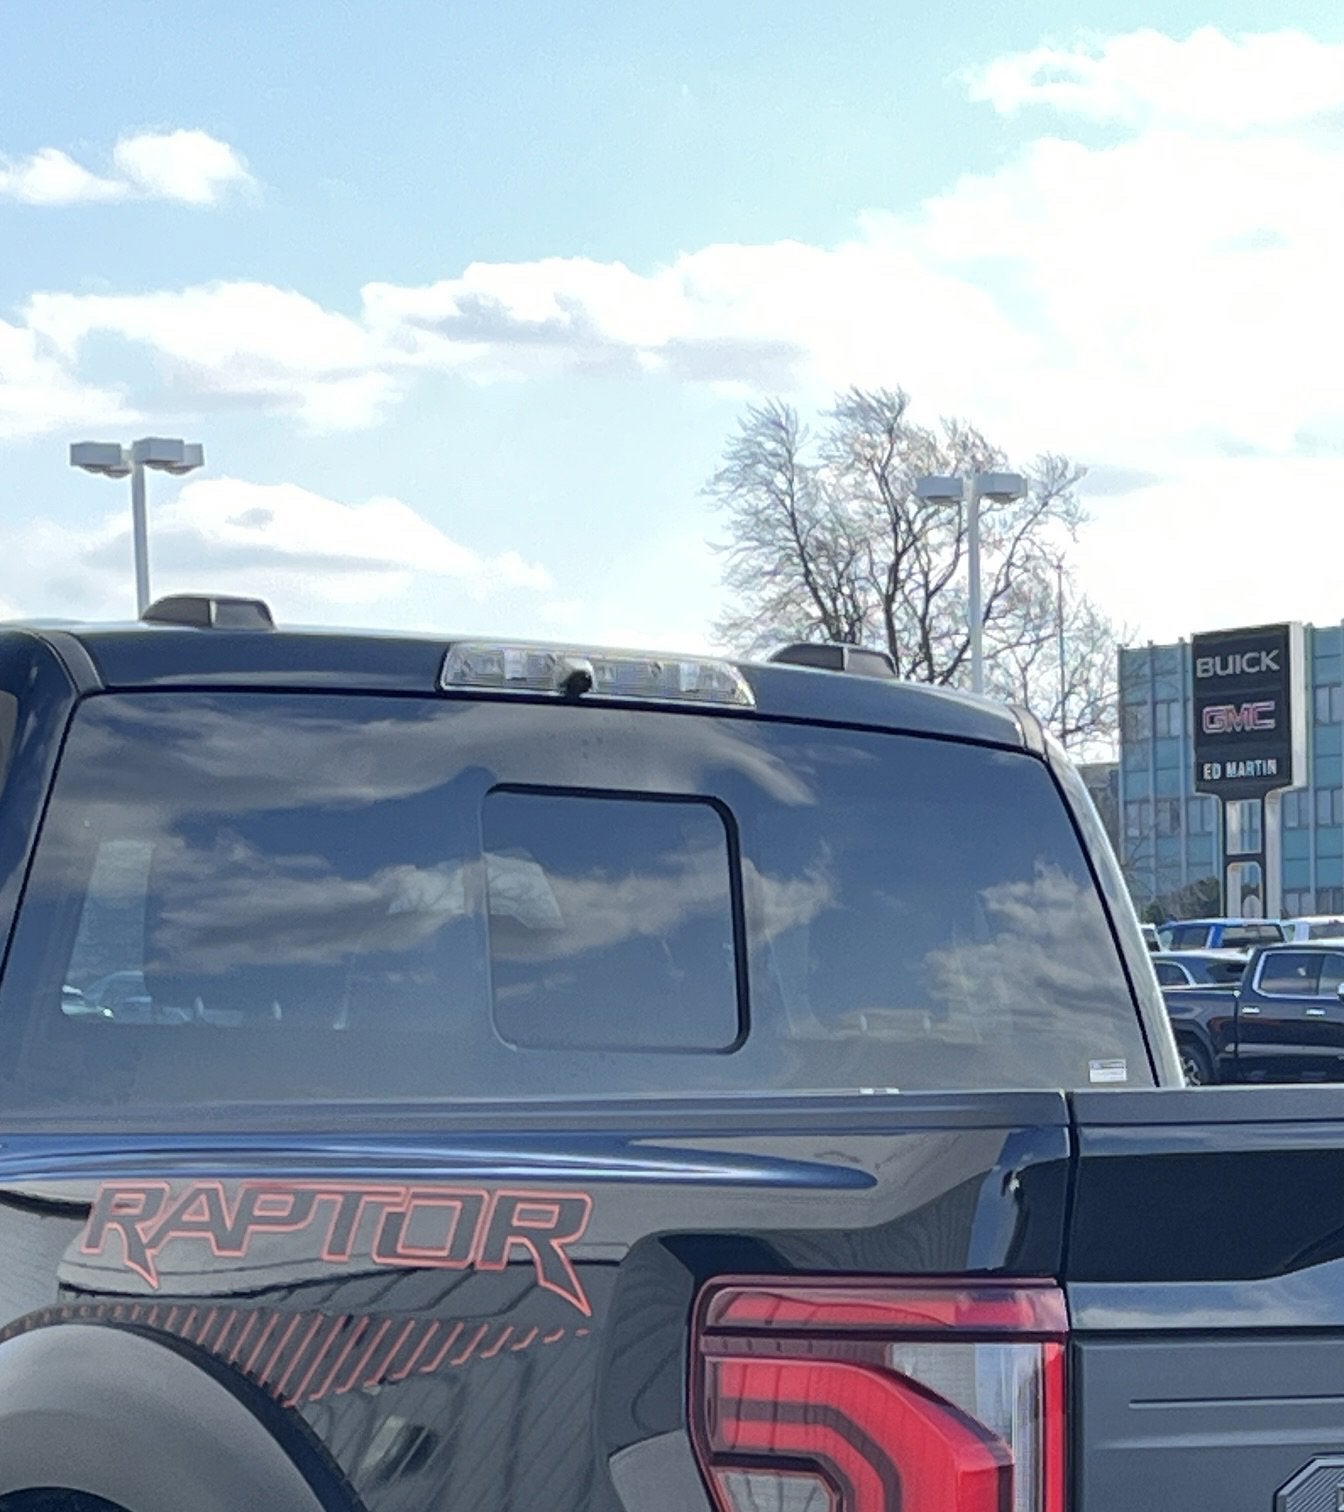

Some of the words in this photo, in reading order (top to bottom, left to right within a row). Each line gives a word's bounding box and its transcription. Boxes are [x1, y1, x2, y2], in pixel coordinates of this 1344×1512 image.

[1196, 650, 1280, 678] BUICK
[1202, 701, 1276, 734] GMC
[1203, 763, 1220, 780] ED
[1226, 759, 1277, 778] MARTIN
[81, 1181, 593, 1316] RAPTOR
